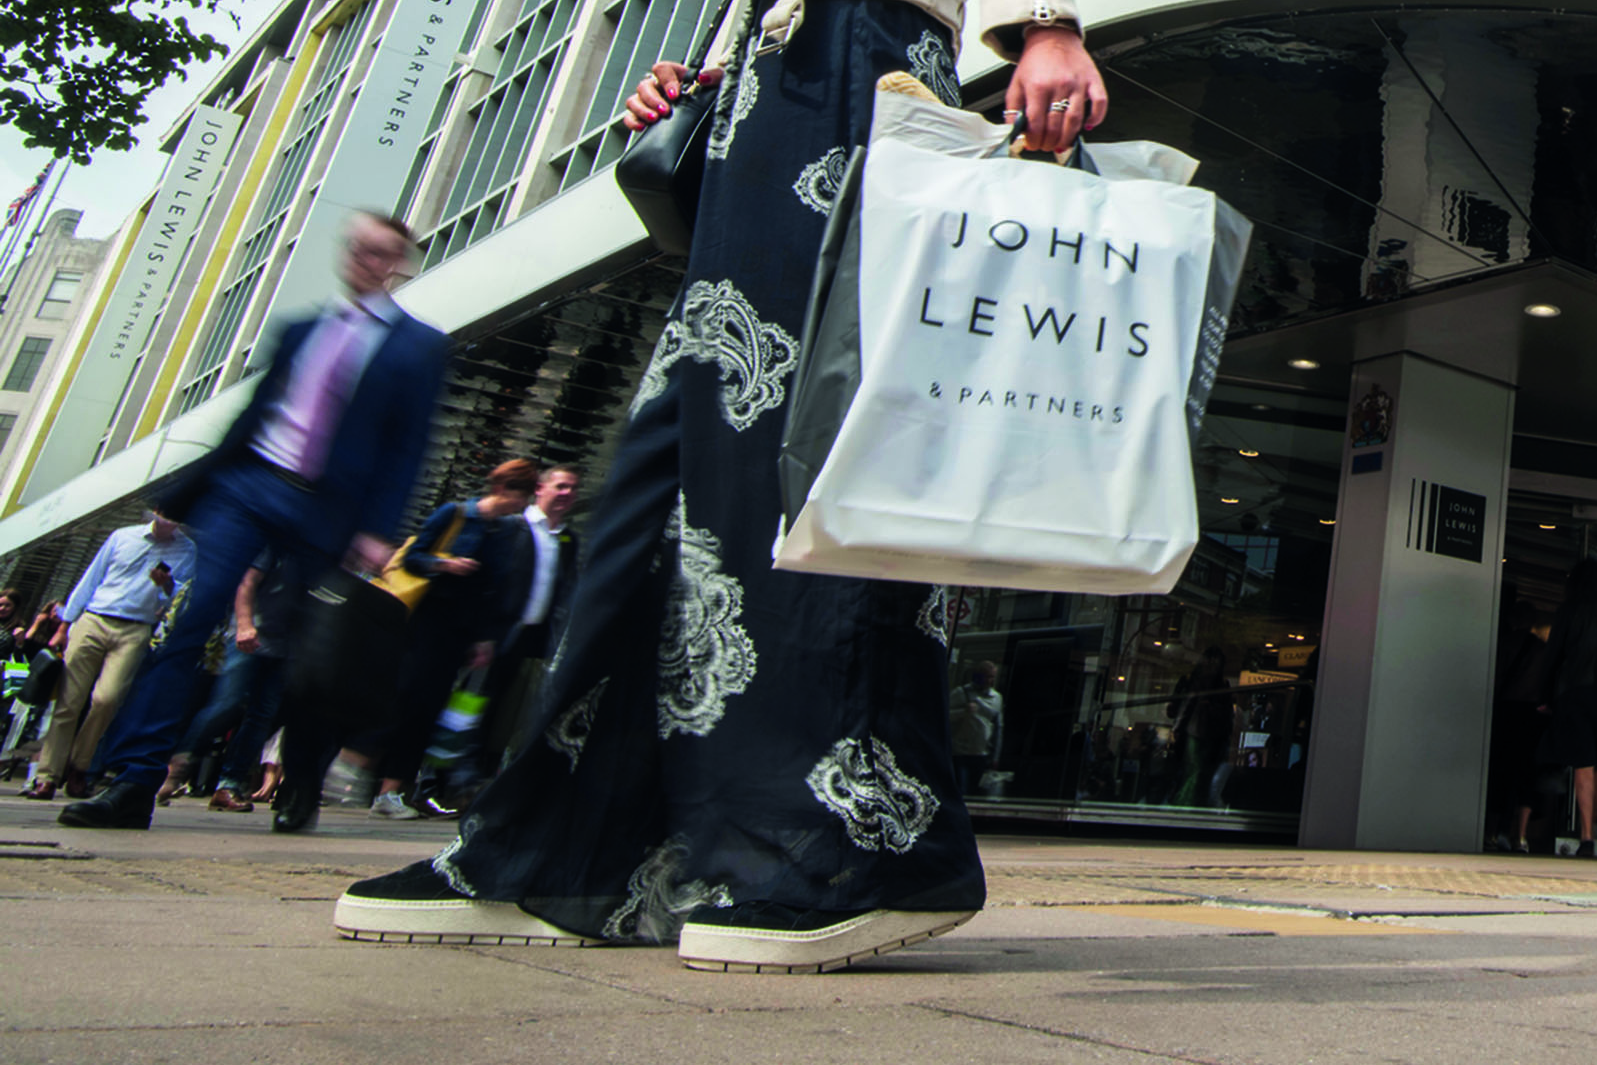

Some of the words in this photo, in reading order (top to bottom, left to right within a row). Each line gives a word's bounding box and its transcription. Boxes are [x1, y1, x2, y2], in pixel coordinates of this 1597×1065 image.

[428, 13, 445, 28] &
[378, 33, 437, 148] PARTNERS
[184, 119, 224, 181] JOHN
[147, 188, 193, 263] LEWIS
[950, 212, 1140, 273] JOHN
[109, 280, 153, 361] PARTNERS
[919, 287, 1151, 357] LEWIS
[928, 381, 943, 400] &
[958, 386, 1125, 425] PARTNERS
[1445, 518, 1477, 533] LEWIS
[1449, 502, 1476, 516] JOHN
